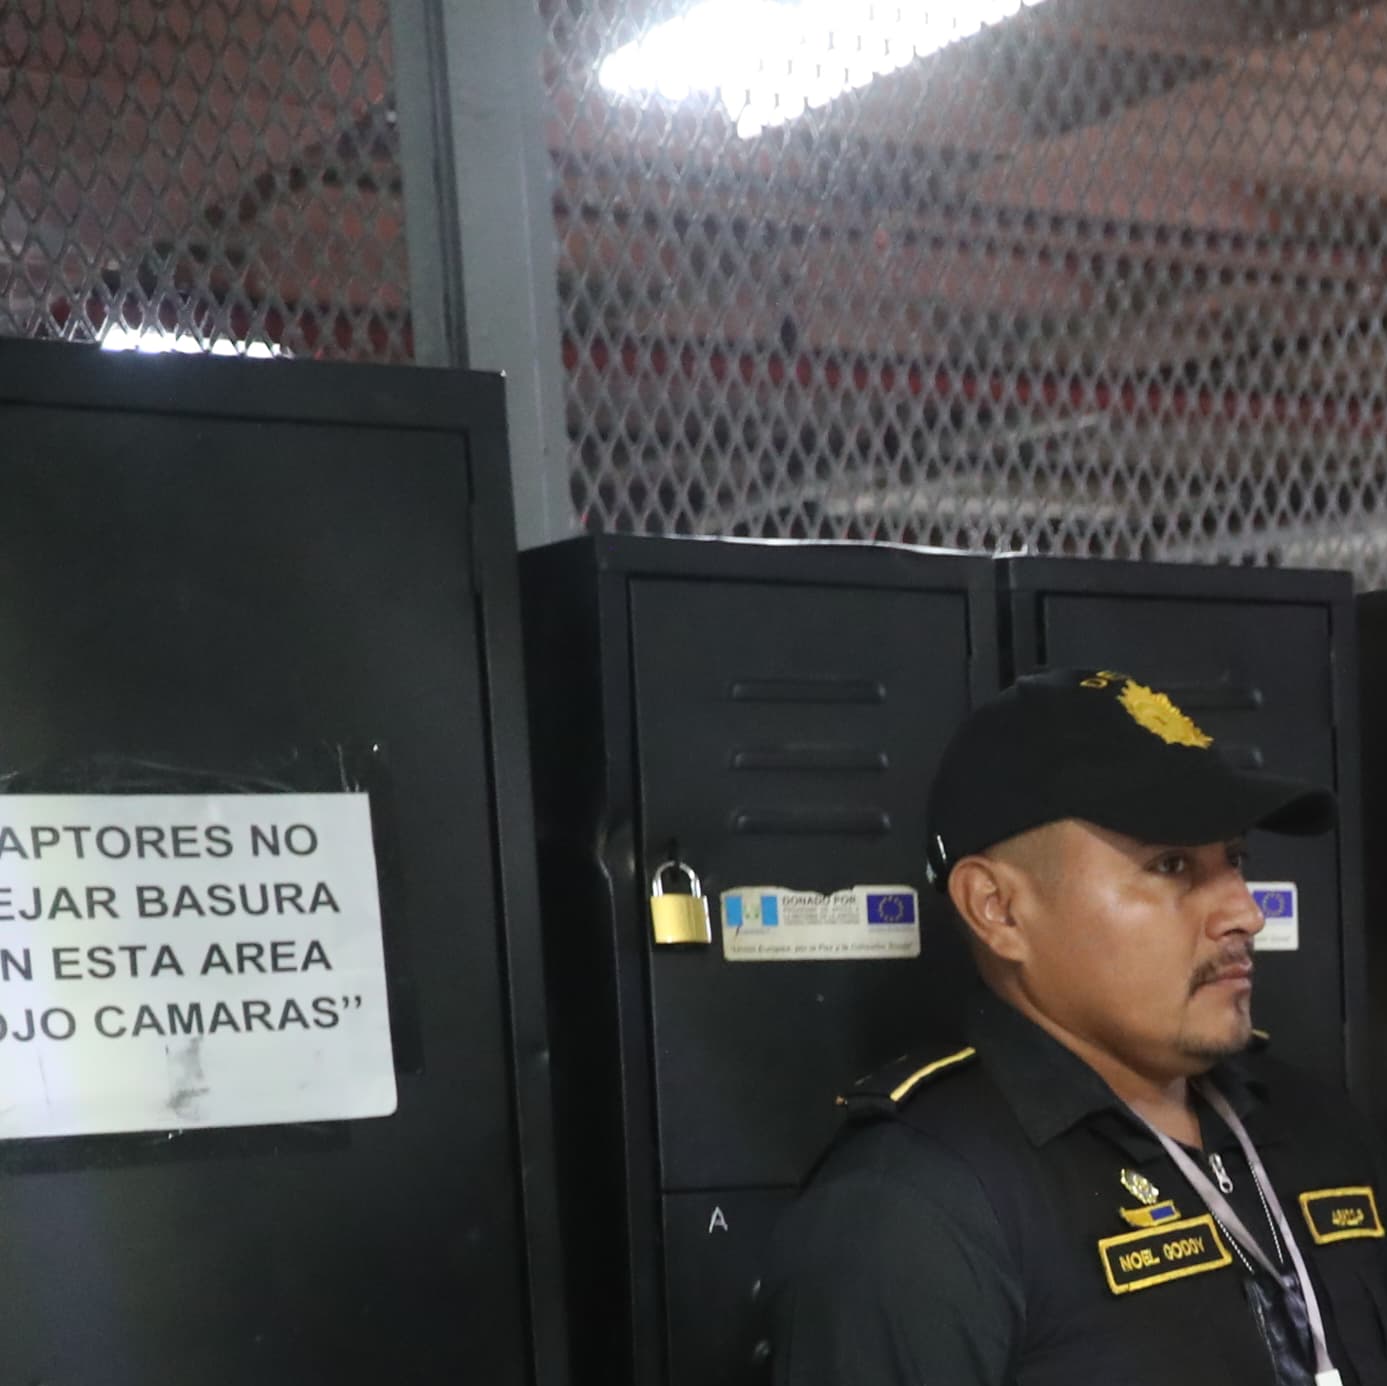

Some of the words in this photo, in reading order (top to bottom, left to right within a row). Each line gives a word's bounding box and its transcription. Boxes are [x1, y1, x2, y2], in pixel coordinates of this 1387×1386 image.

[0, 825, 234, 860] APTORES
[250, 823, 319, 857] NO
[135, 881, 341, 918] BASURA
[52, 944, 184, 981] ESTA
[200, 939, 332, 975] AREA
[0, 1007, 77, 1042] JO
[1119, 1247, 1160, 1272] NOEL
